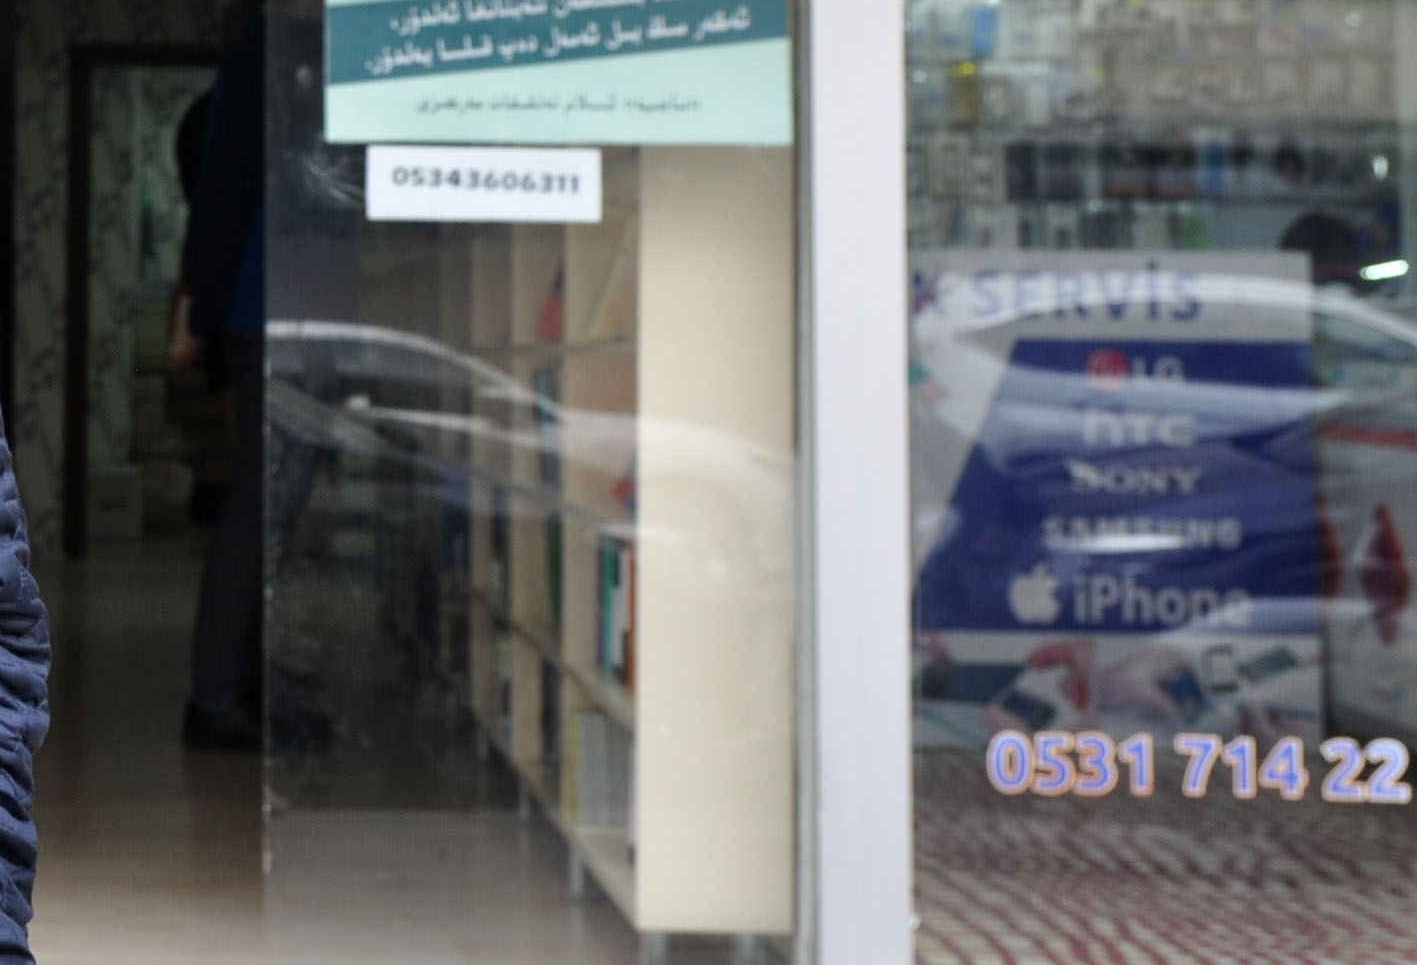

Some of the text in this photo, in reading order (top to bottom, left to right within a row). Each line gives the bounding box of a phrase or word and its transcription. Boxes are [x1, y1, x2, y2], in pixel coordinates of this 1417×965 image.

[392, 166, 580, 195] 05343606311
[1068, 464, 1202, 494] SONY
[1041, 515, 1243, 551] SAMSUNG
[1073, 571, 1253, 627] iPhone
[986, 730, 1413, 805] 0531 714 22
